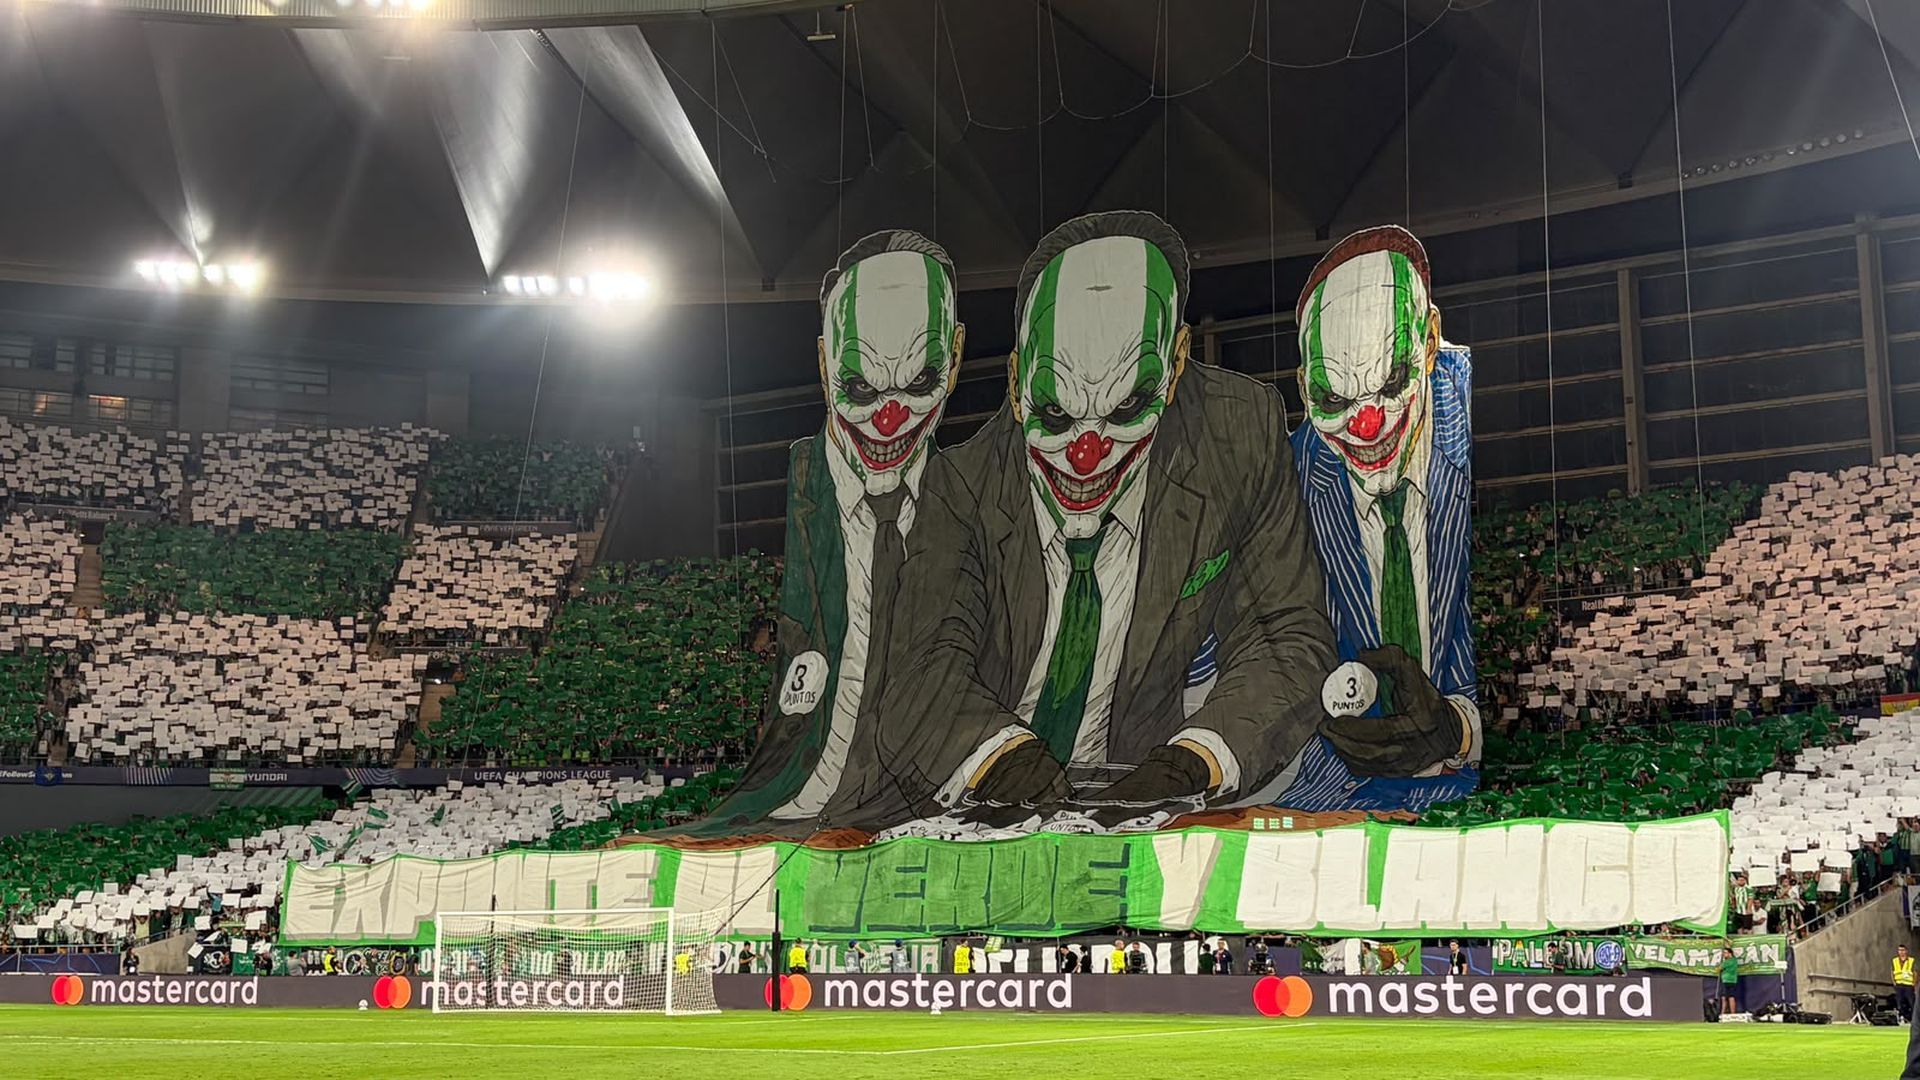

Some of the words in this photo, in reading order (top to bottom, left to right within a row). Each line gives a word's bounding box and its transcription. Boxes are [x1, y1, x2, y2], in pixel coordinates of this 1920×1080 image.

[791, 664, 807, 691] 3
[1346, 677, 1357, 698] 3
[784, 691, 816, 706] PUNTOS
[1333, 699, 1365, 711] PUNTOS
[474, 771, 502, 781] UEFA
[571, 769, 611, 779] LEAGUE
[806, 842, 1130, 934] VERDE
[1152, 832, 1222, 930] Y
[1236, 823, 1728, 931] BLANCO
[90, 975, 259, 1004] mastercard
[421, 976, 625, 1006] mastercard
[824, 973, 1073, 1009] mastercard
[1328, 975, 1652, 1017] mastercard
